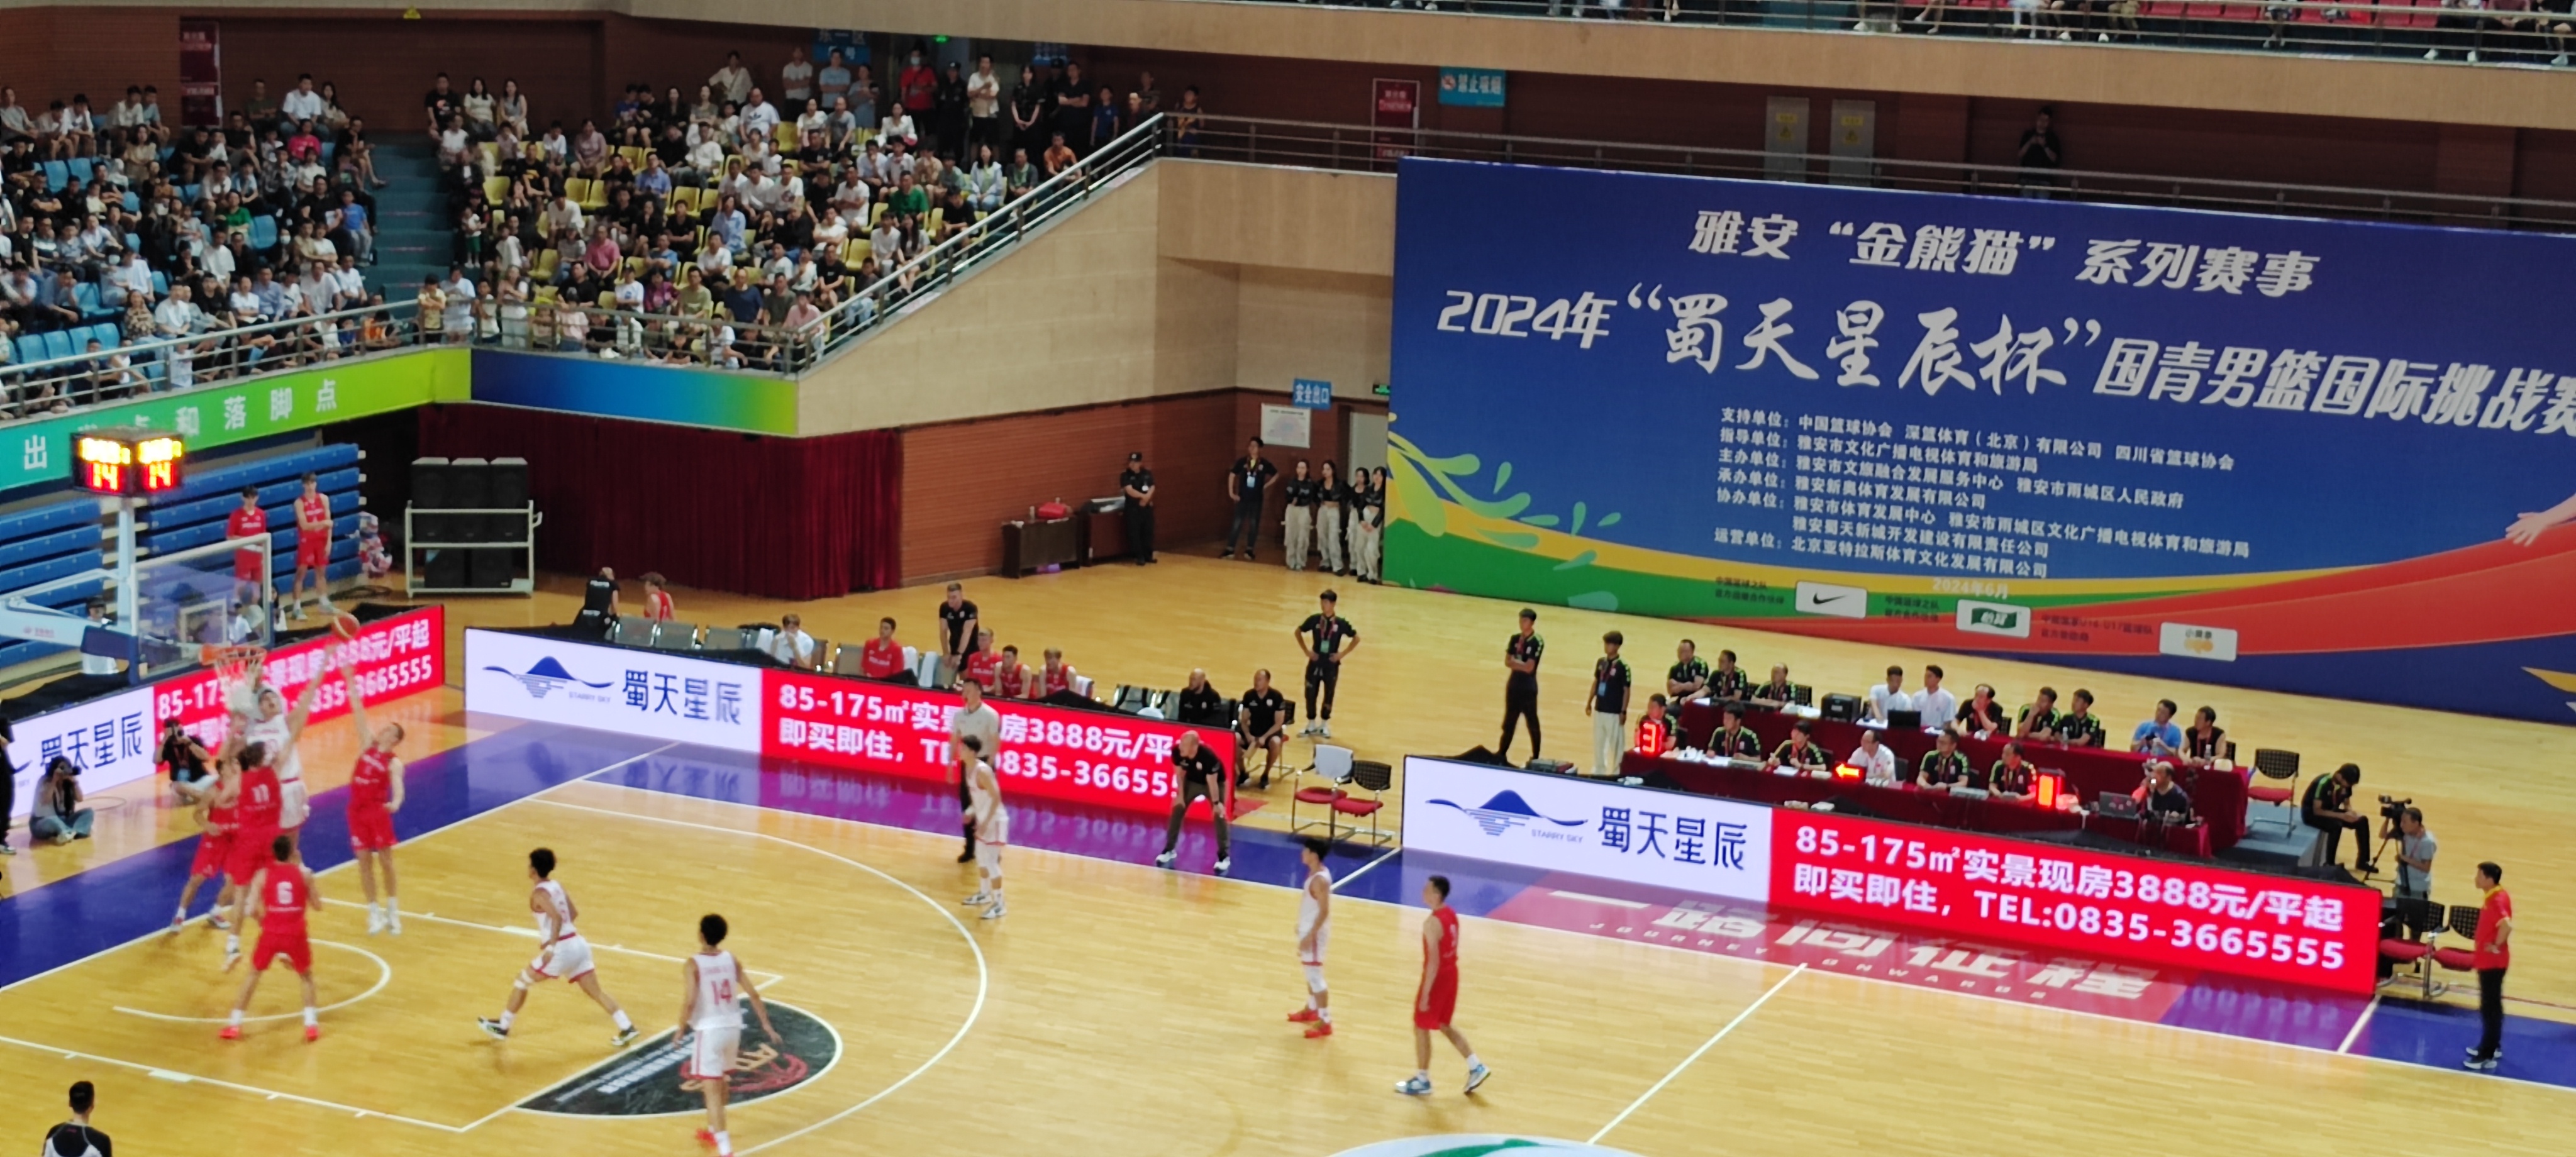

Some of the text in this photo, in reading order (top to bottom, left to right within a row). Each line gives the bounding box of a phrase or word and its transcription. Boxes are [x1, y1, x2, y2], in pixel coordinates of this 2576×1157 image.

[2116, 445, 2235, 471] 四川省篮球协会
[93, 462, 118, 490] 14
[149, 462, 171, 489] 14
[2016, 477, 2184, 509] 雅安市雨城区人民政府
[1932, 577, 2009, 599] 2024年6月
[622, 669, 742, 725] 蜀天星辰
[1598, 805, 1748, 871] 蜀天星辰
[711, 978, 733, 1005] 14
